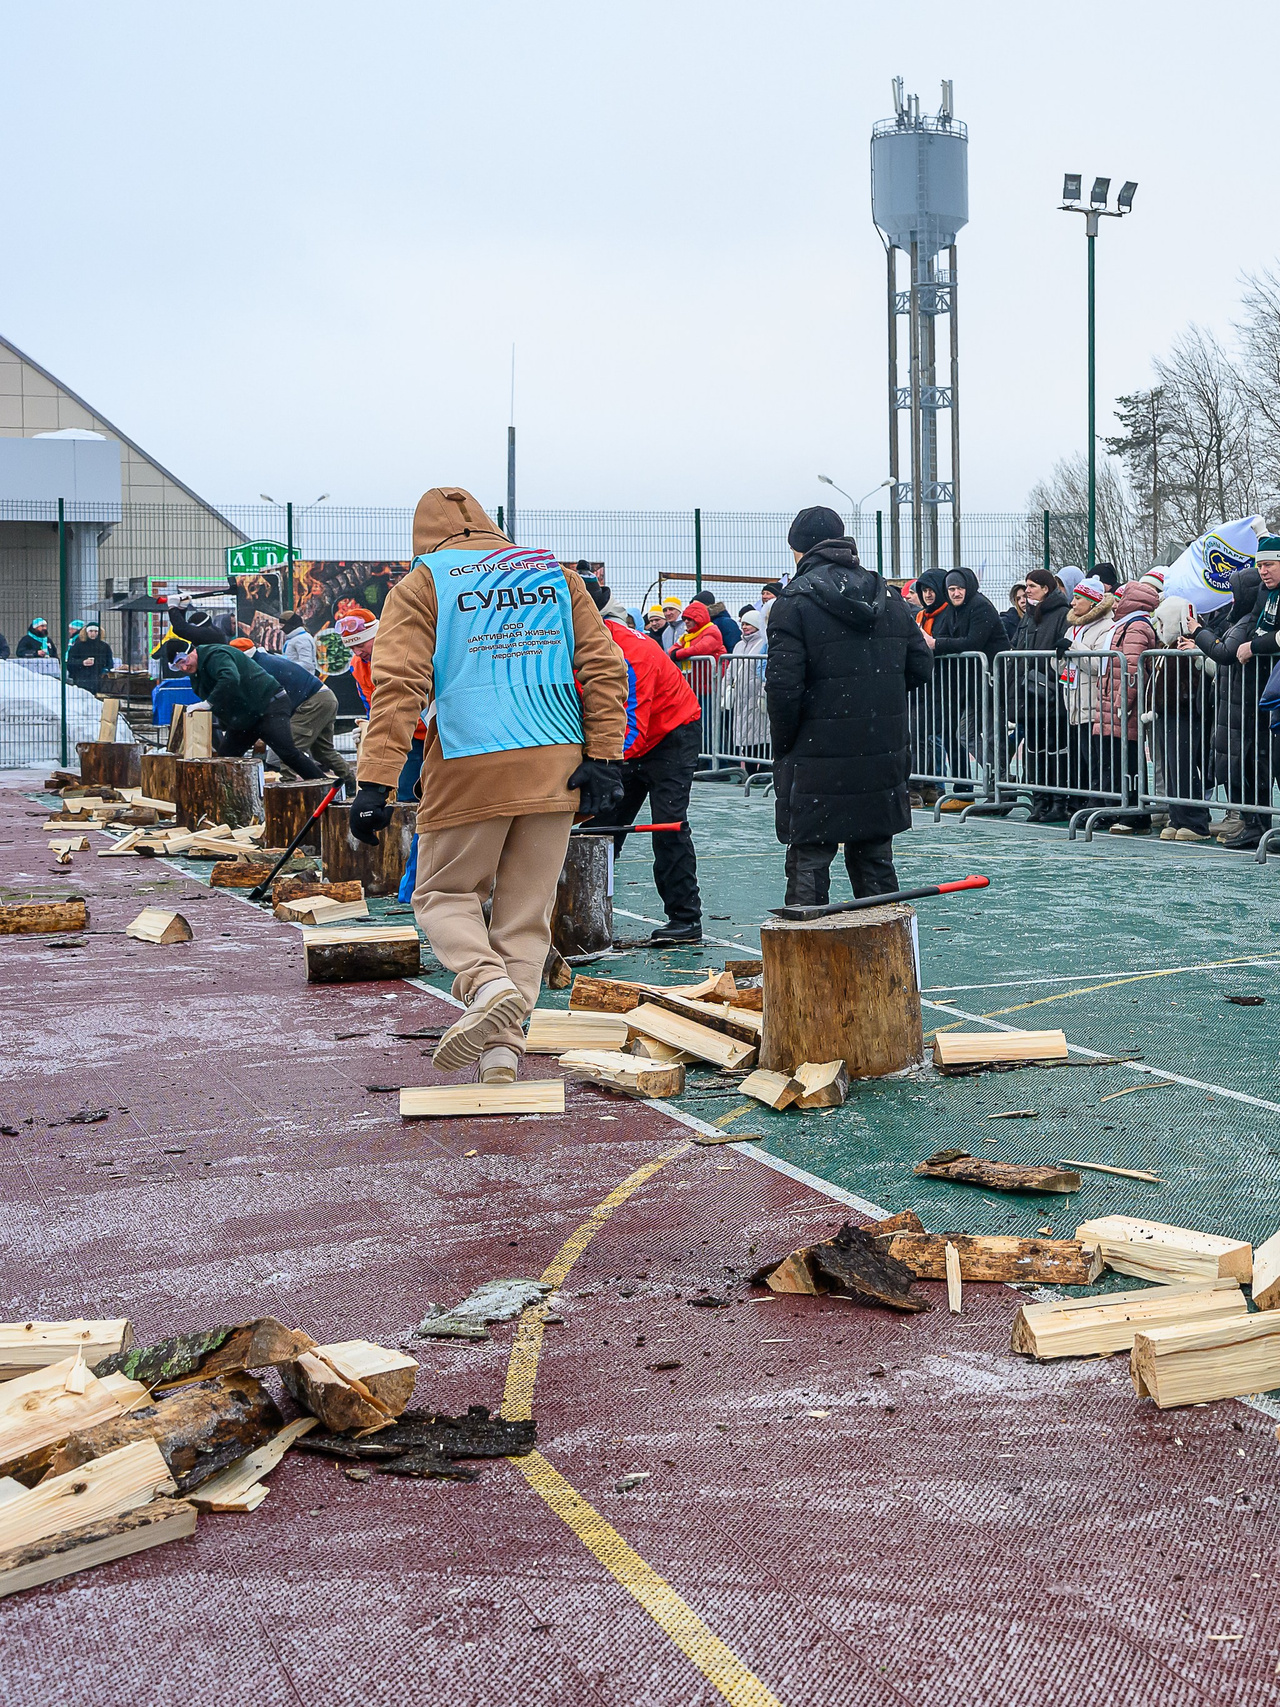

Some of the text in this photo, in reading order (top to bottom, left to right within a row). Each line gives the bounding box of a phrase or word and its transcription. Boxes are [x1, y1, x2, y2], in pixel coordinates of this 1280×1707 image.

[1223, 546, 1246, 560] ПАРК
[457, 585, 557, 612] СУДЬЯ
[502, 622, 524, 630] ООО
[467, 629, 560, 644] «АКТИВНАЯ ЖИЗНЬ»
[469, 639, 561, 653] организация спортивных
[491, 648, 543, 660] мероприятий
